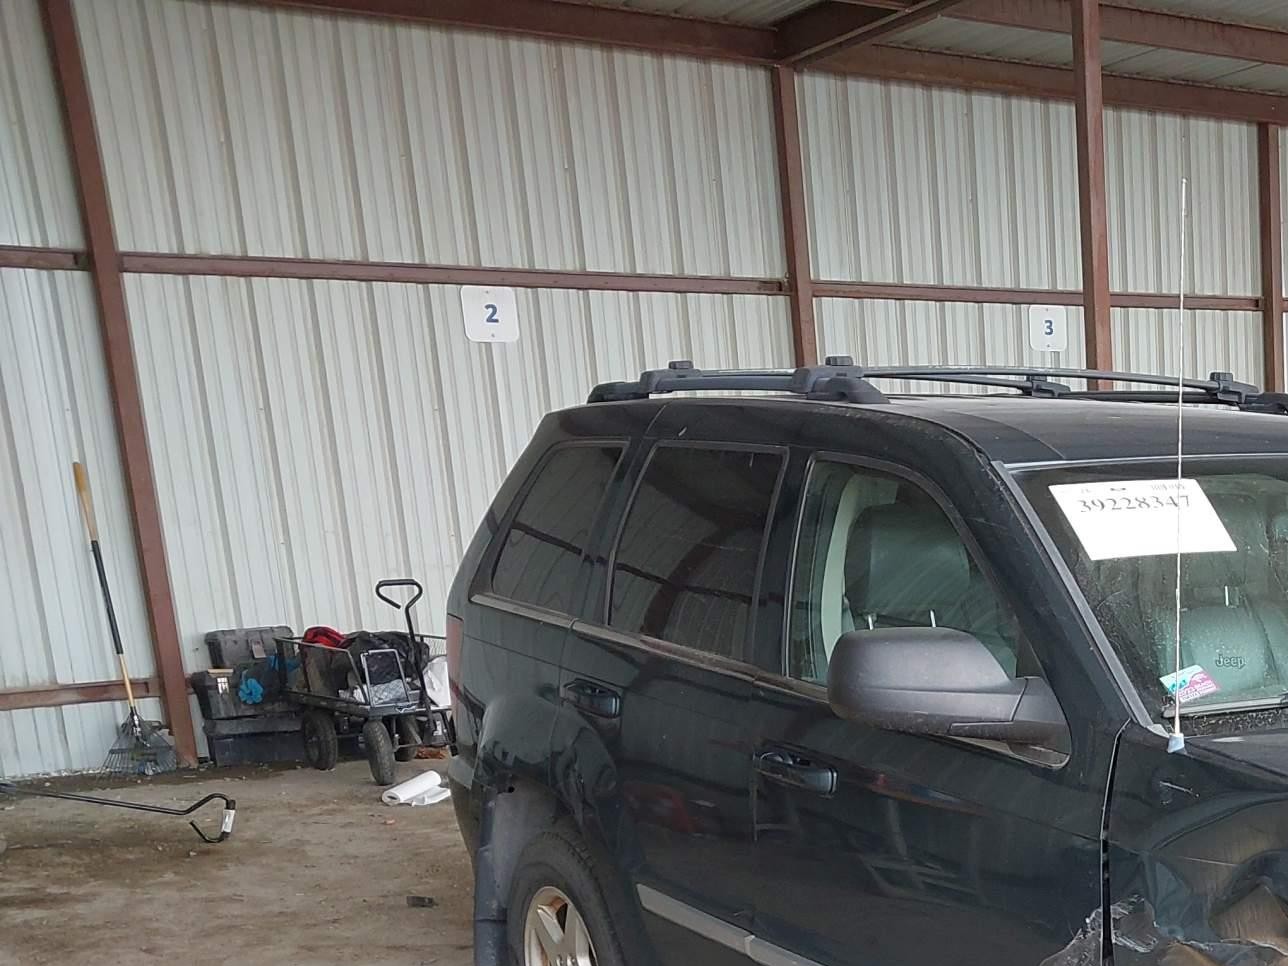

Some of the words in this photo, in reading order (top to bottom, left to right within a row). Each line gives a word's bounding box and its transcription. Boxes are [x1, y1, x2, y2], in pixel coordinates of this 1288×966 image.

[484, 303, 500, 323] 2
[1044, 319, 1054, 336] 3
[1078, 495, 1190, 513] 39228347
[1215, 653, 1248, 670] Jeep
